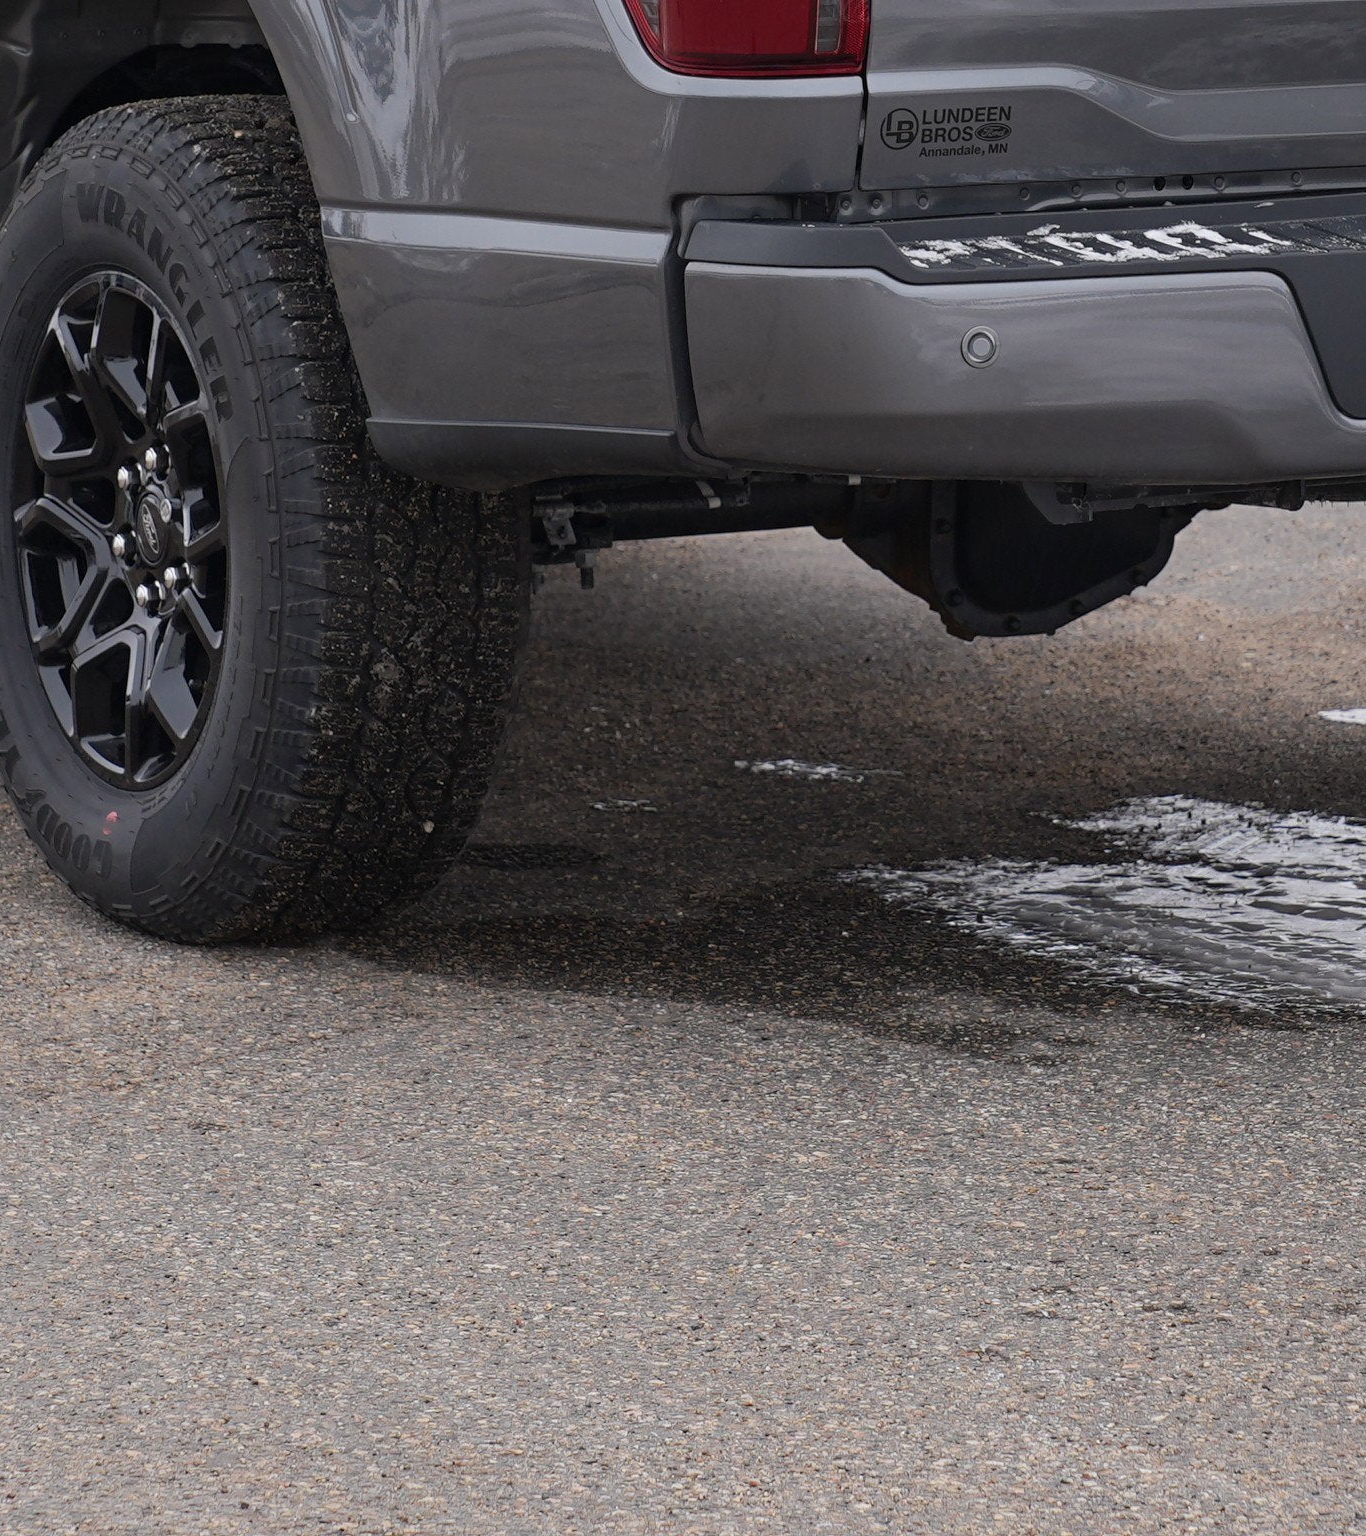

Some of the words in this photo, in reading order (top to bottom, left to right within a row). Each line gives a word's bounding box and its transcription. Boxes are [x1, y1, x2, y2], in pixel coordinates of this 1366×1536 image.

[923, 107, 1011, 124] LUNDEEN
[922, 127, 973, 143] BROS
[919, 144, 986, 158] Annandale,
[988, 143, 1008, 154] MN
[76, 181, 233, 423] WRANGLER
